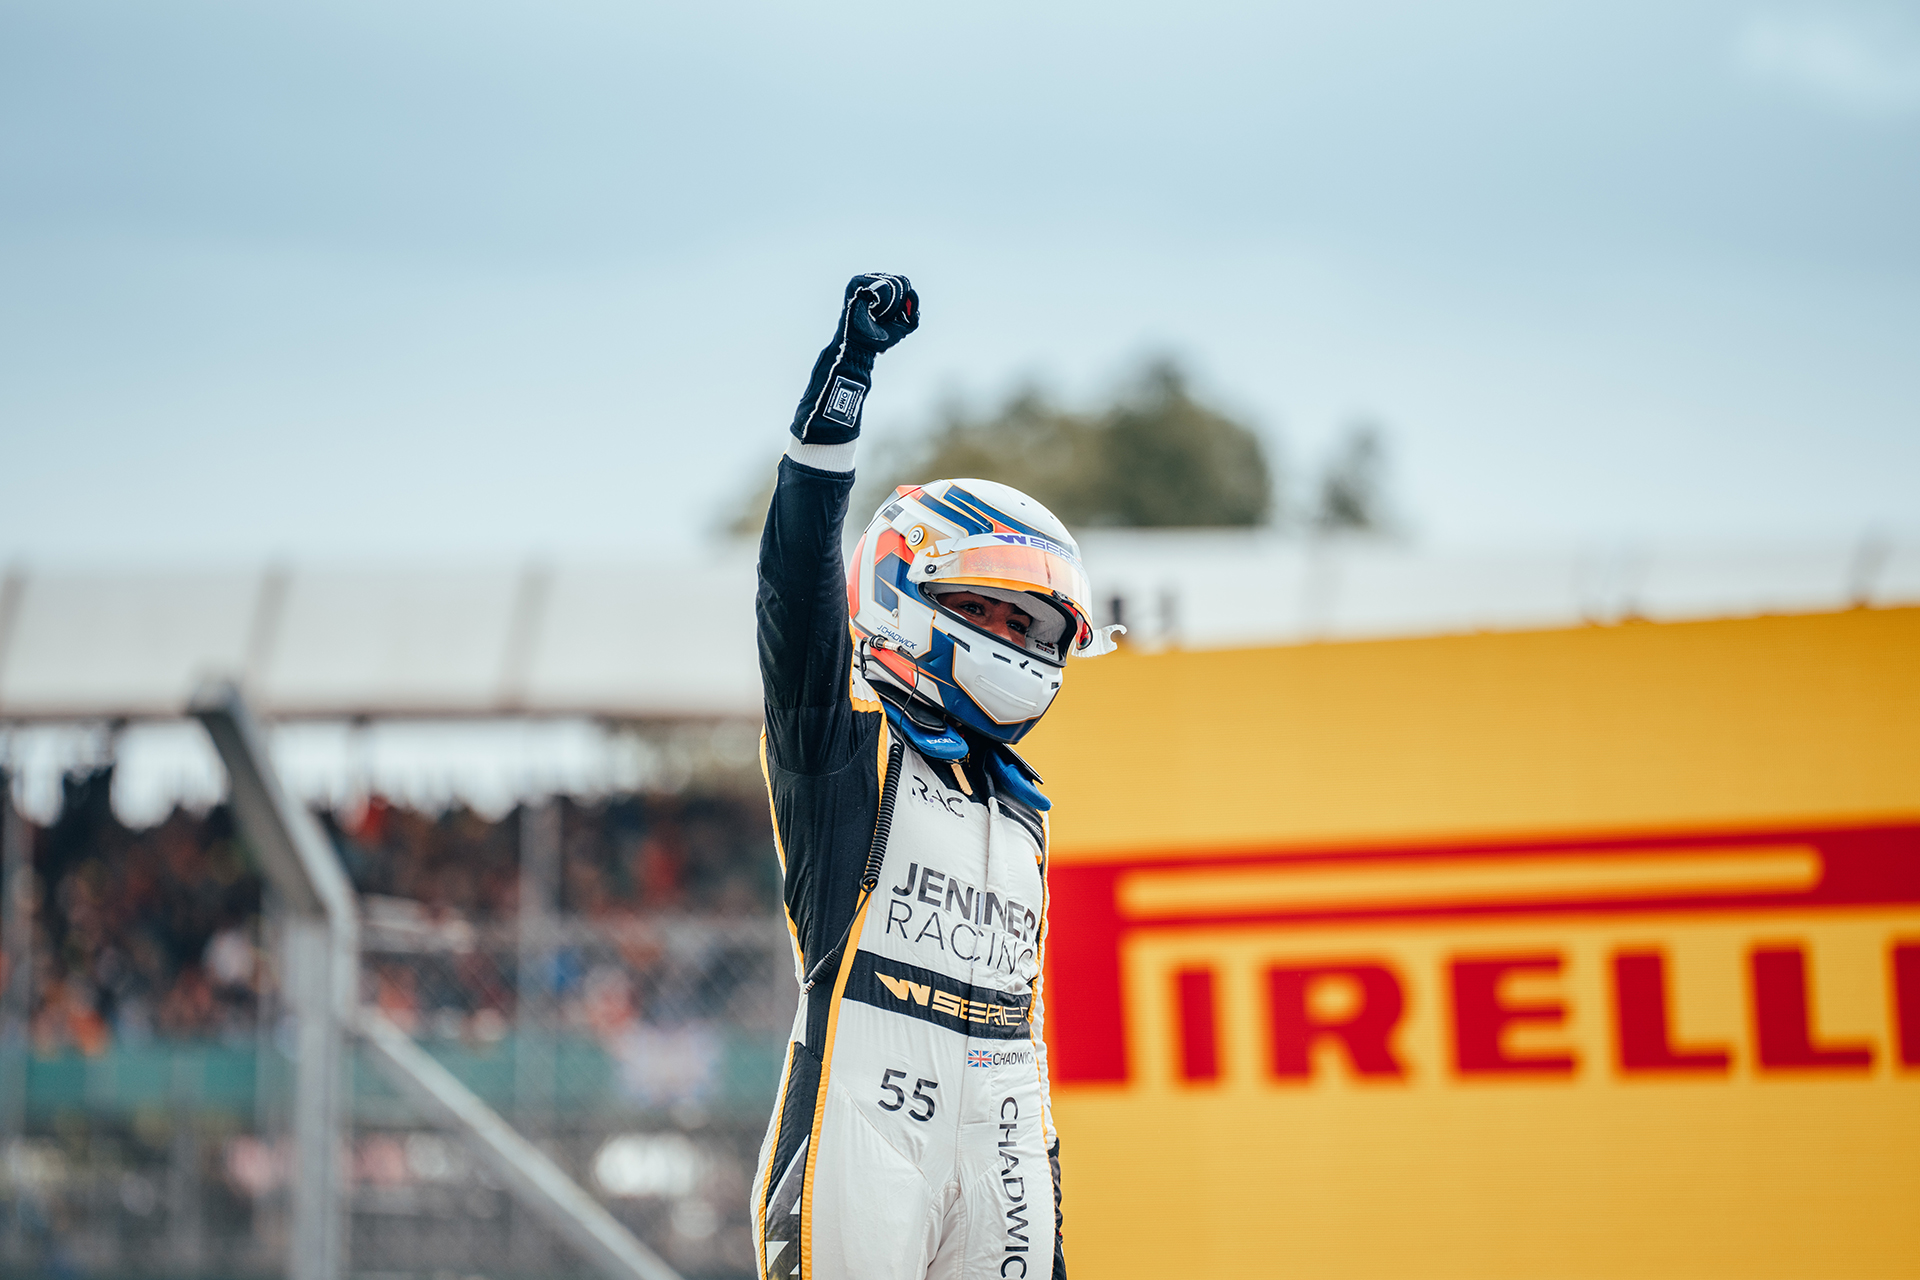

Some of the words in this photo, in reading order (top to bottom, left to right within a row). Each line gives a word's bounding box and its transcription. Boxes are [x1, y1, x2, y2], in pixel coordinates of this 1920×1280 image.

[839, 391, 848, 410] OMP
[891, 862, 1036, 943] JENNER
[992, 1051, 1036, 1066] CHADWIC
[877, 1068, 939, 1122] 55
